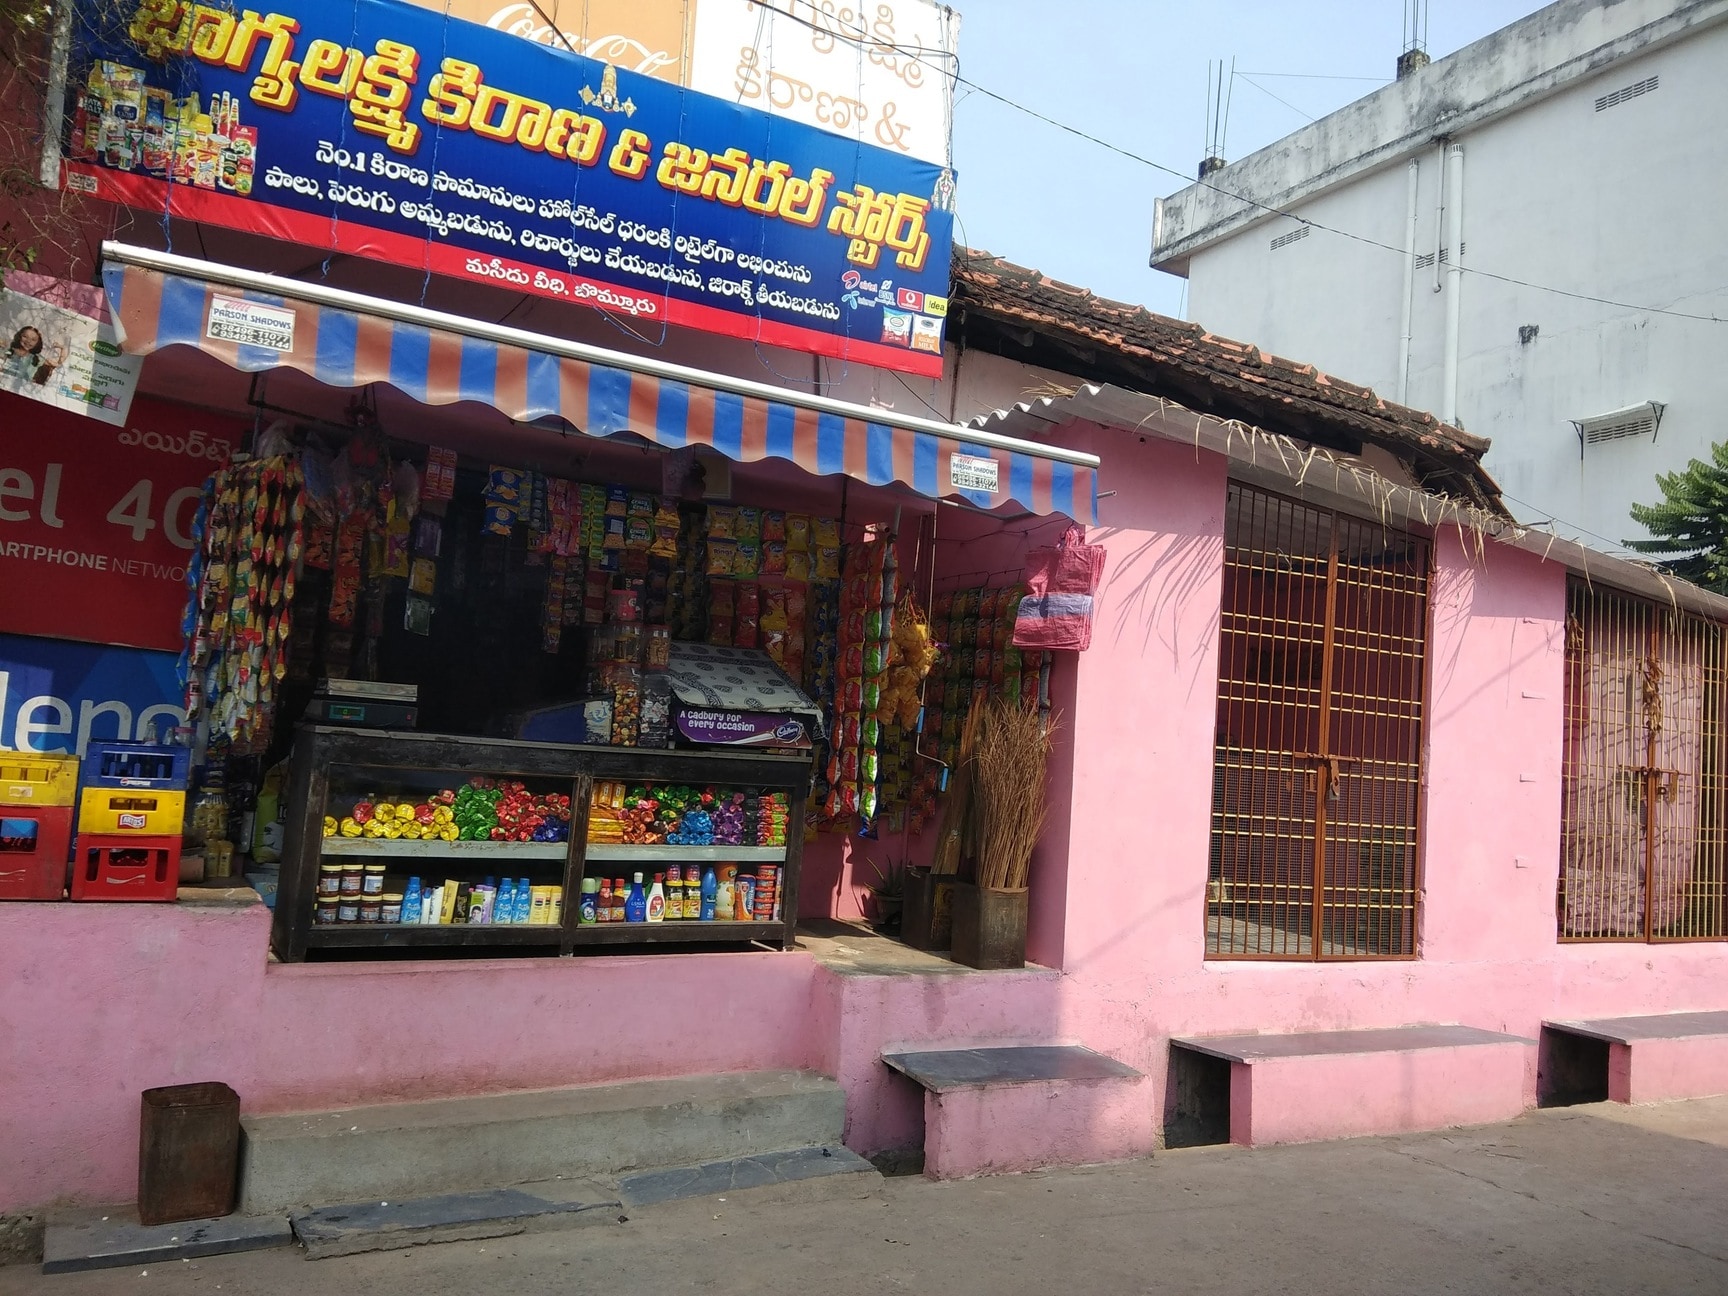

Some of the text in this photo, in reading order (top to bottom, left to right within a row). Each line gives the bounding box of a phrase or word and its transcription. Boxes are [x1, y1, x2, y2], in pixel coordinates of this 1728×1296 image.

[874, 101, 911, 152] &
[421, 57, 606, 168] కిరాణ
[608, 128, 652, 181] &
[656, 141, 834, 229] జనరల్
[213, 307, 248, 321] PARSON
[250, 315, 291, 330] SHADOWS
[219, 330, 290, 349] 93495-32144
[220, 323, 290, 342] 98496-11077
[679, 710, 686, 719] A
[726, 712, 742, 722] for
[687, 719, 755, 732] every occasion
